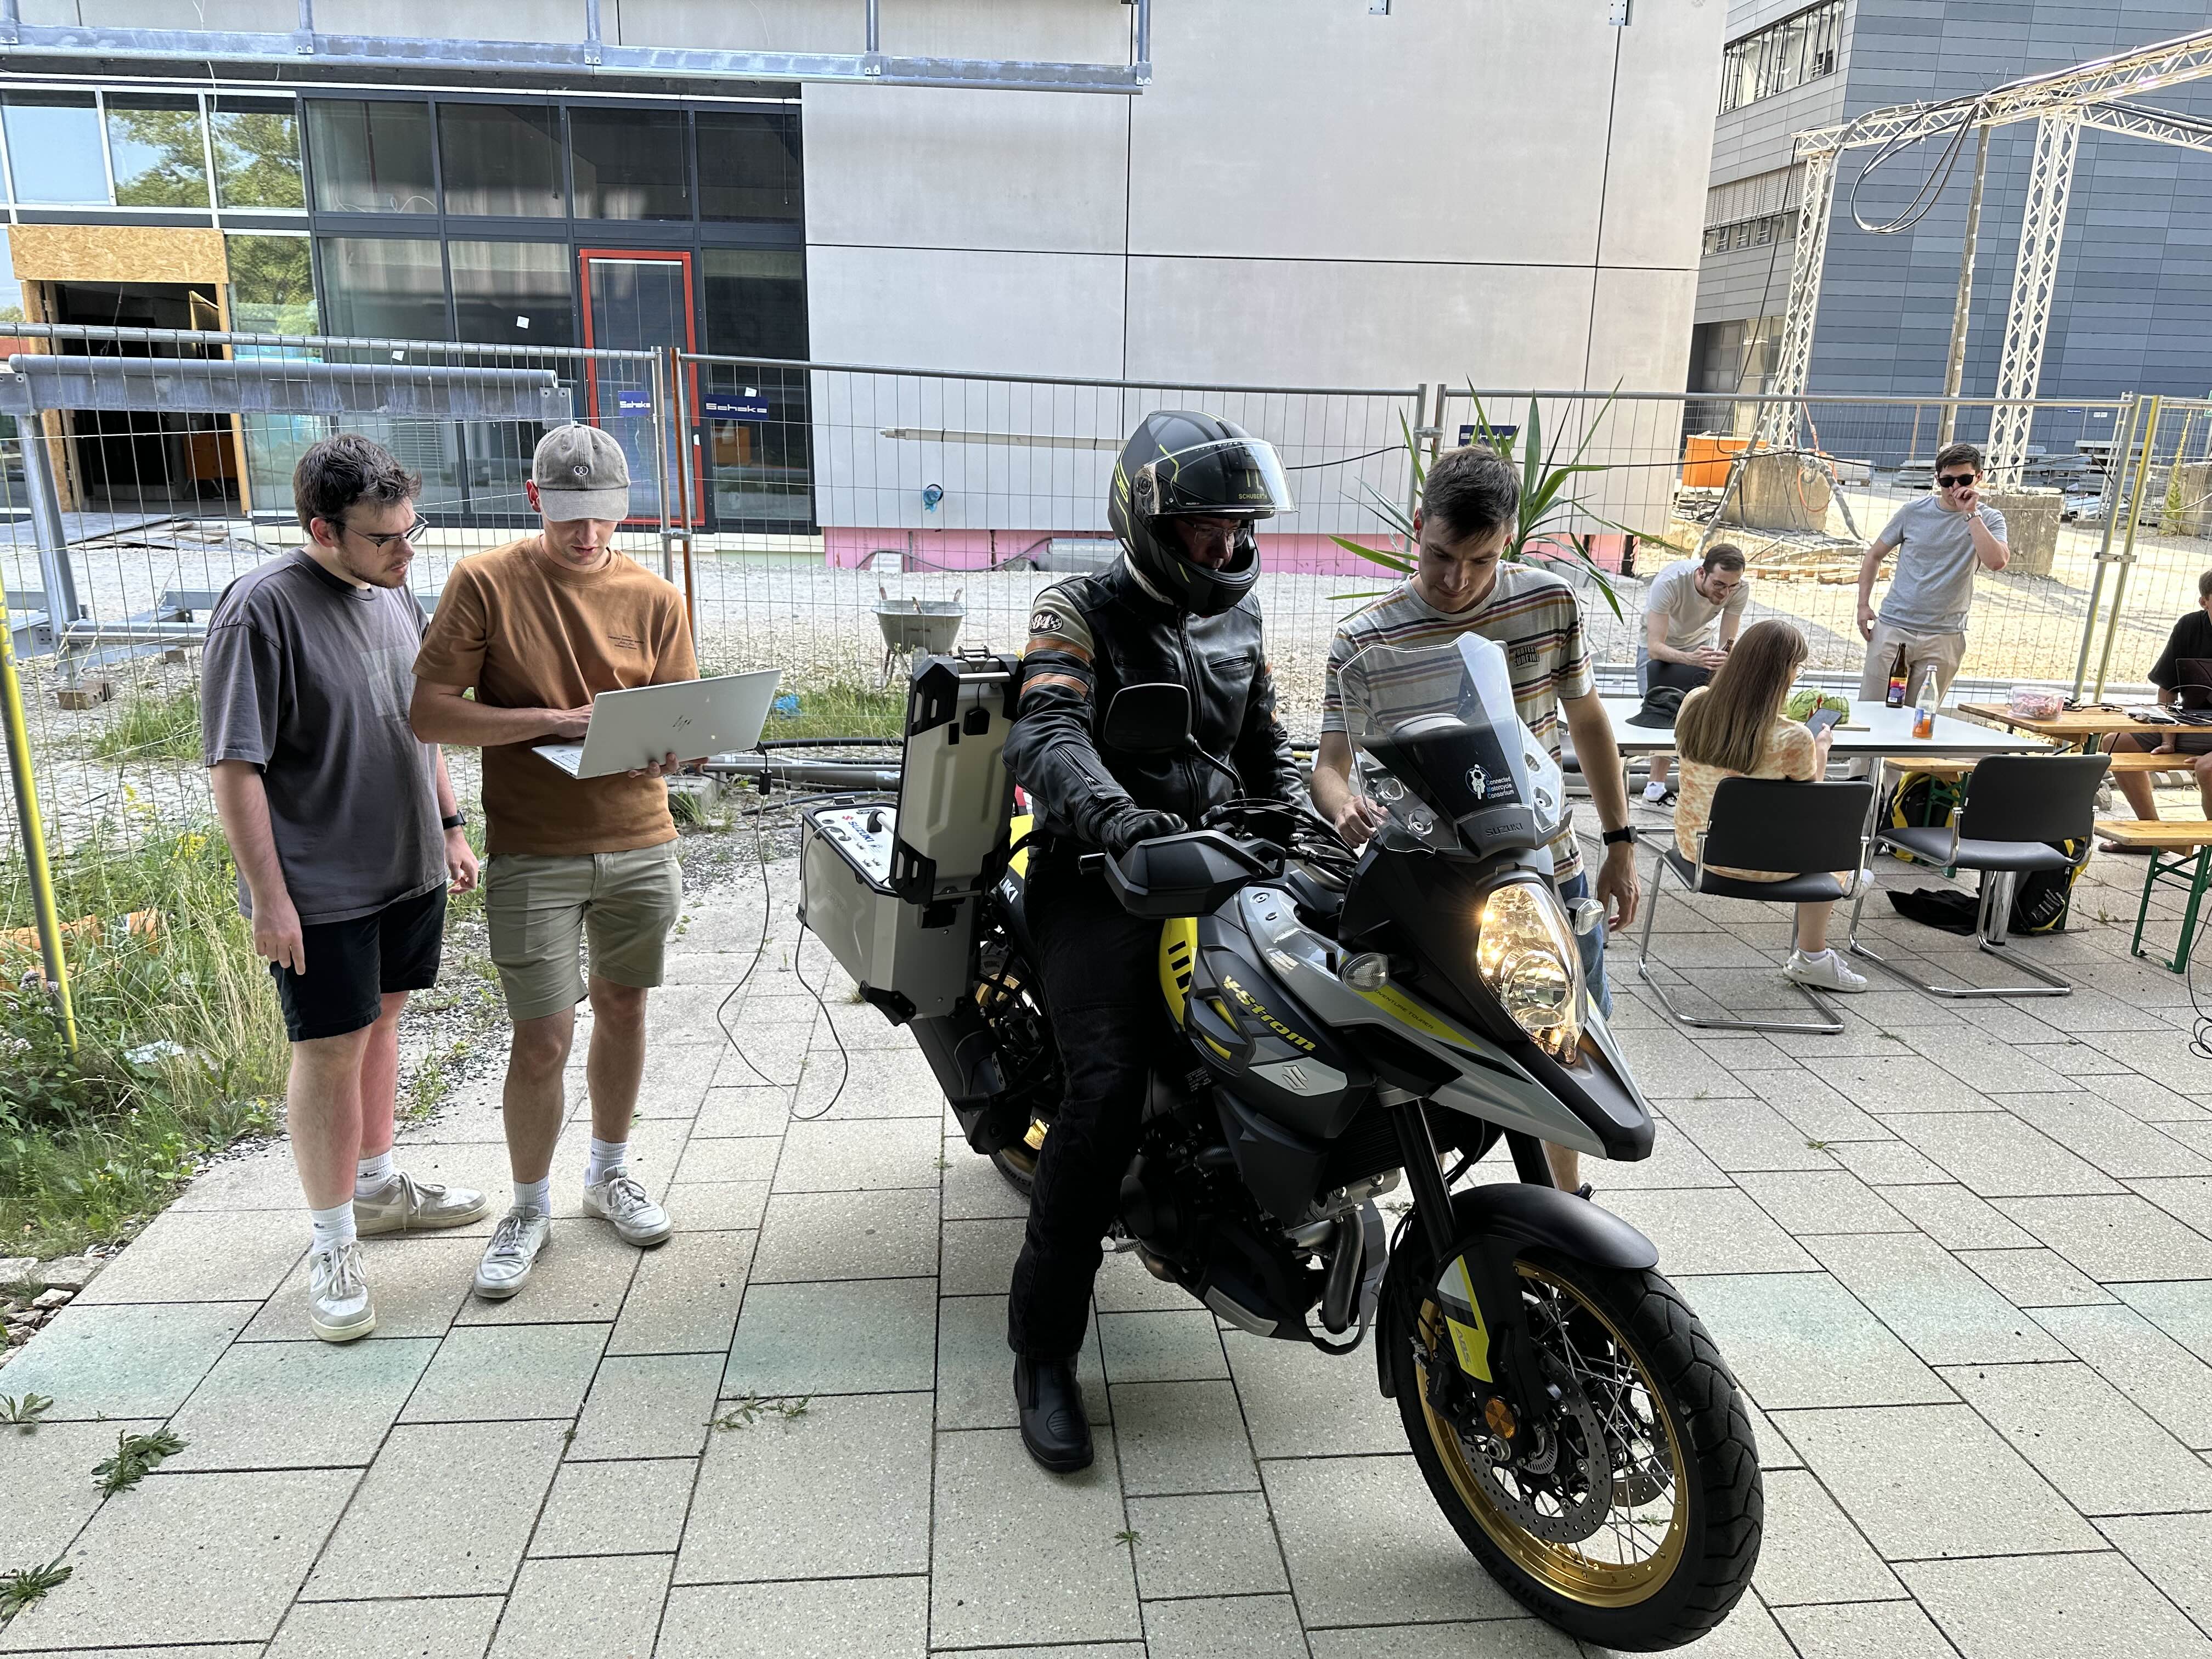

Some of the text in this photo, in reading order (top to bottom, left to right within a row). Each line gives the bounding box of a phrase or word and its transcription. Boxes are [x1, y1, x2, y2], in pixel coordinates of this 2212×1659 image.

[706, 403, 768, 414] Schake
[1031, 613, 1053, 629] 84
[1513, 645, 1537, 658] PROTEST
[1513, 652, 1541, 668] SURFING
[1486, 775, 1511, 786] Connected
[1486, 782, 1513, 793] Motorcycle
[1487, 789, 1514, 799] Consortium
[848, 821, 875, 843] SUZUKI
[1485, 822, 1523, 837] SUZUKI
[997, 876, 1019, 904] UKI
[1374, 989, 1434, 1029] DVENTURE TOURER
